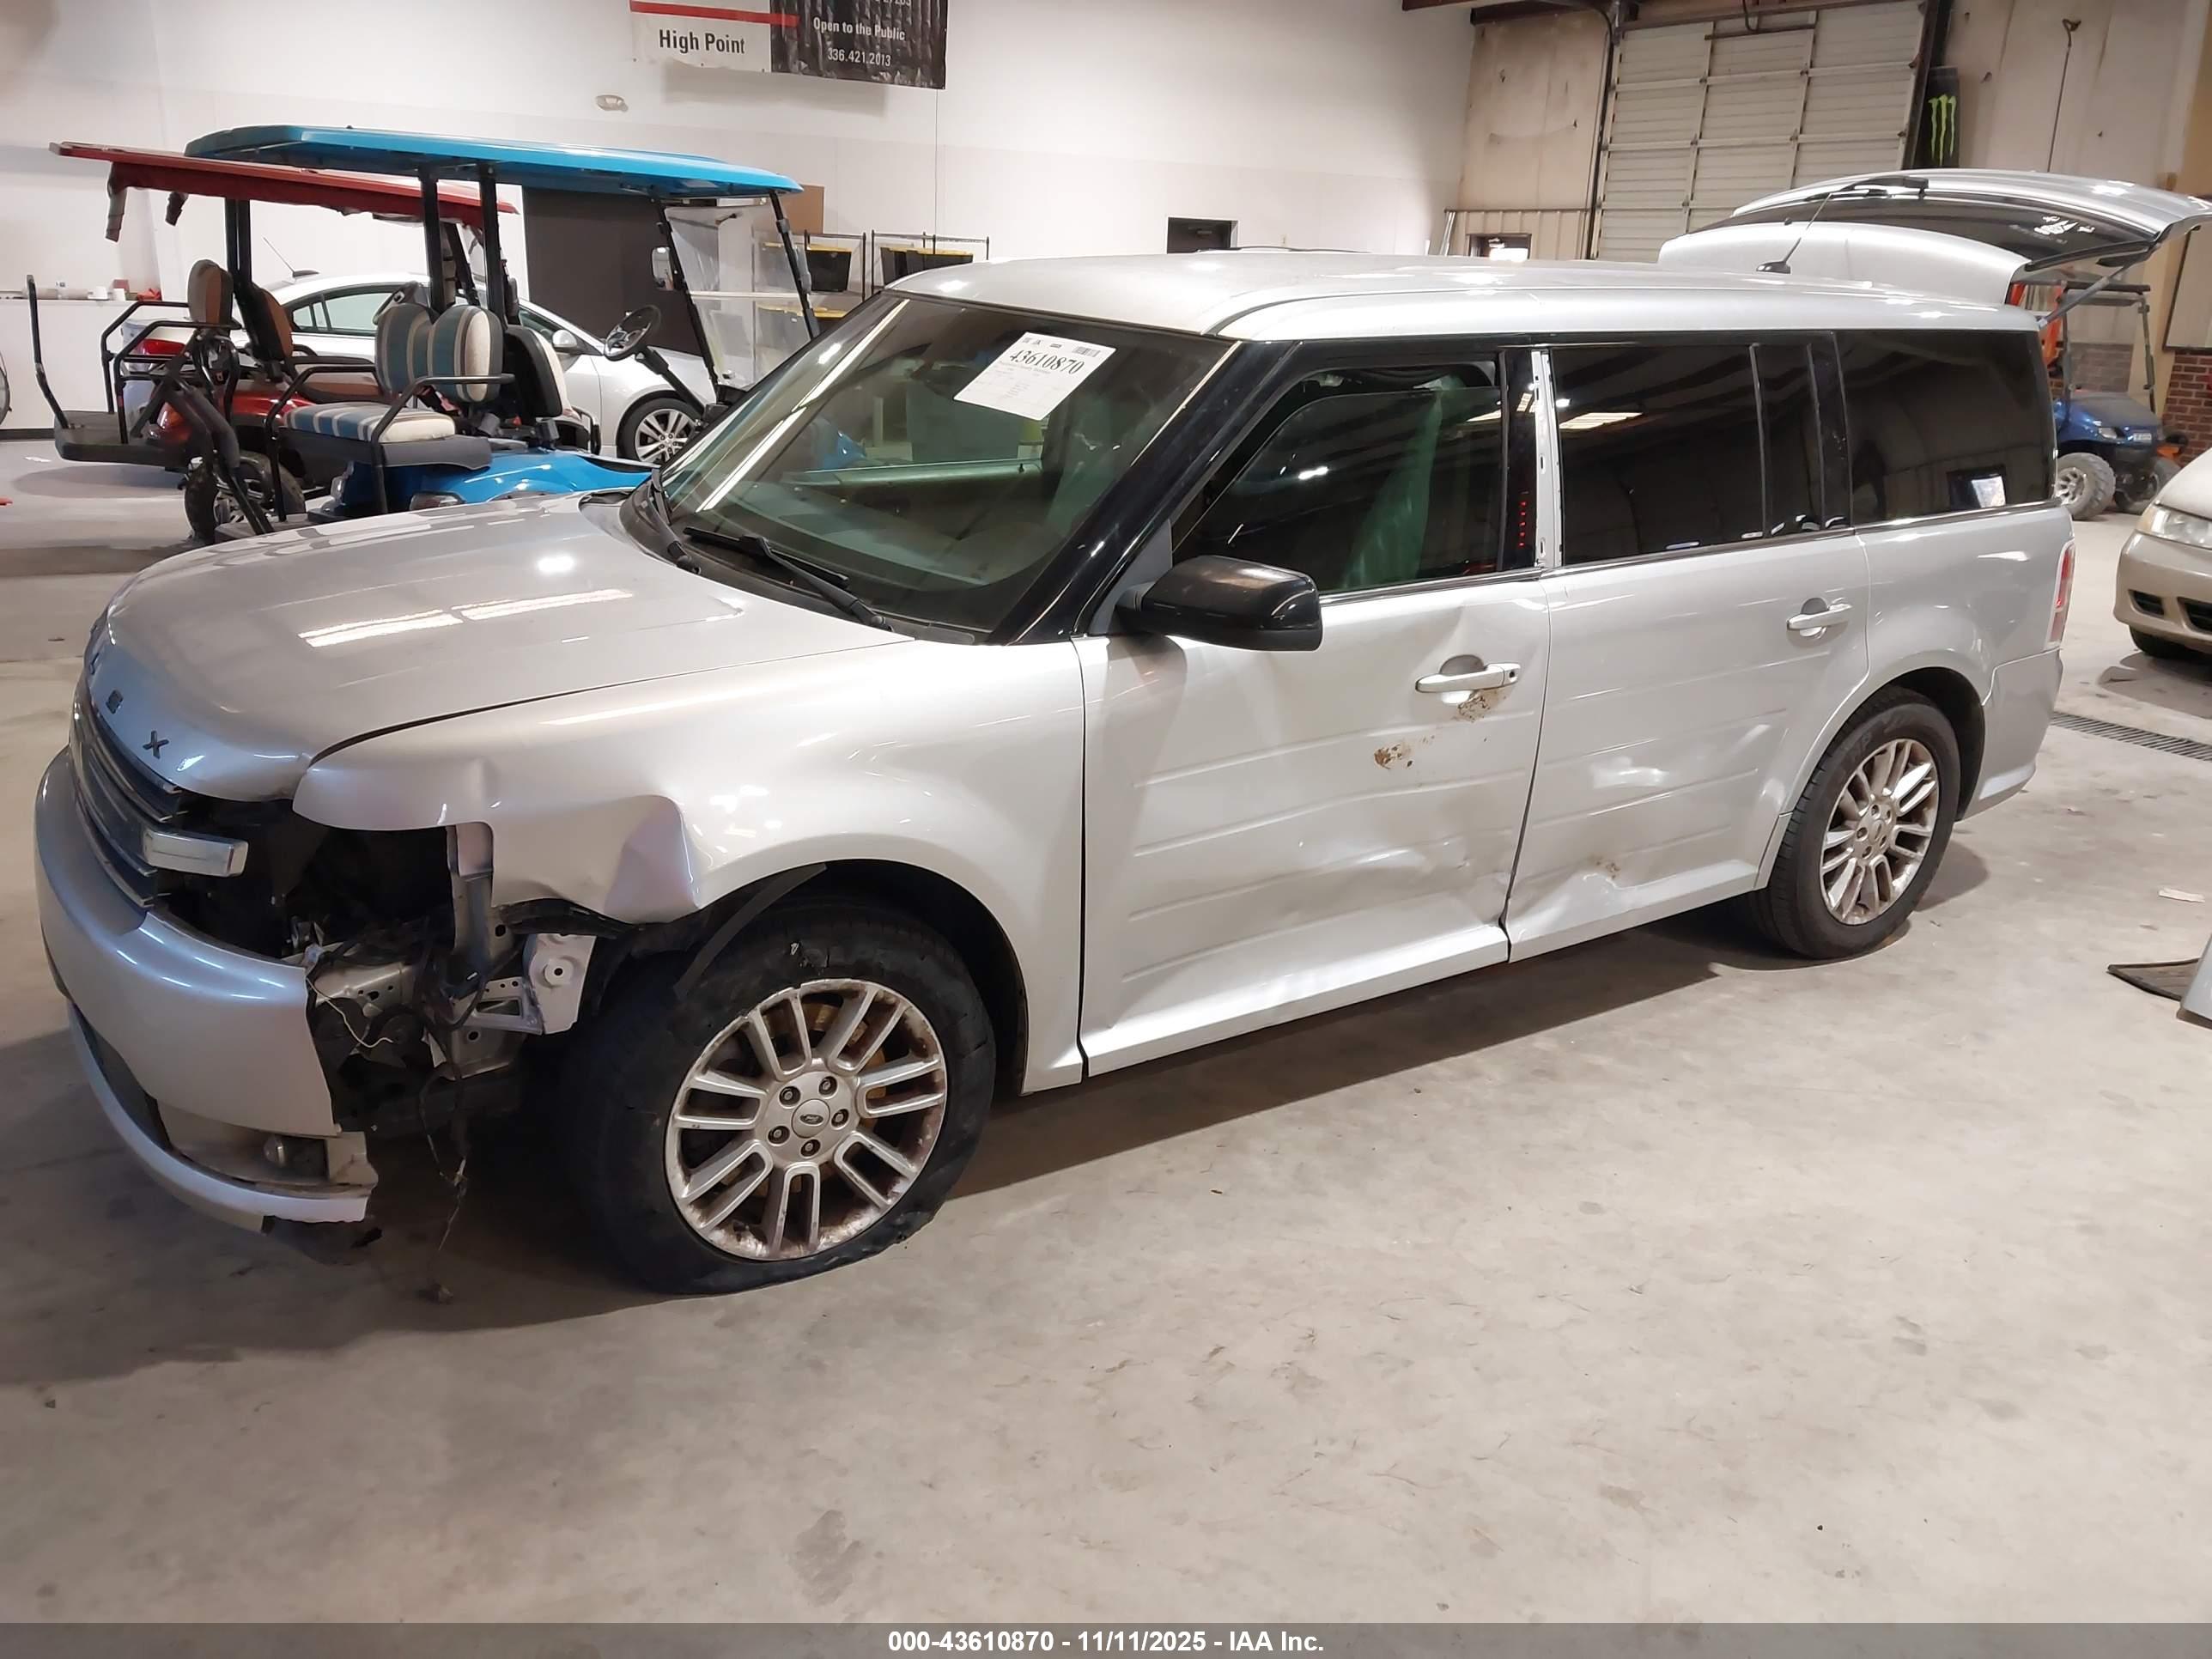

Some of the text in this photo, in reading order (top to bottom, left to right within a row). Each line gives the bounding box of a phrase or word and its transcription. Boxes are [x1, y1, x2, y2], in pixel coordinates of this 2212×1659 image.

[813, 16, 906, 41] Open to the Public
[659, 29, 745, 55] High Point
[827, 47, 891, 67] 336.421.2013
[1010, 349, 1085, 374] 43610870
